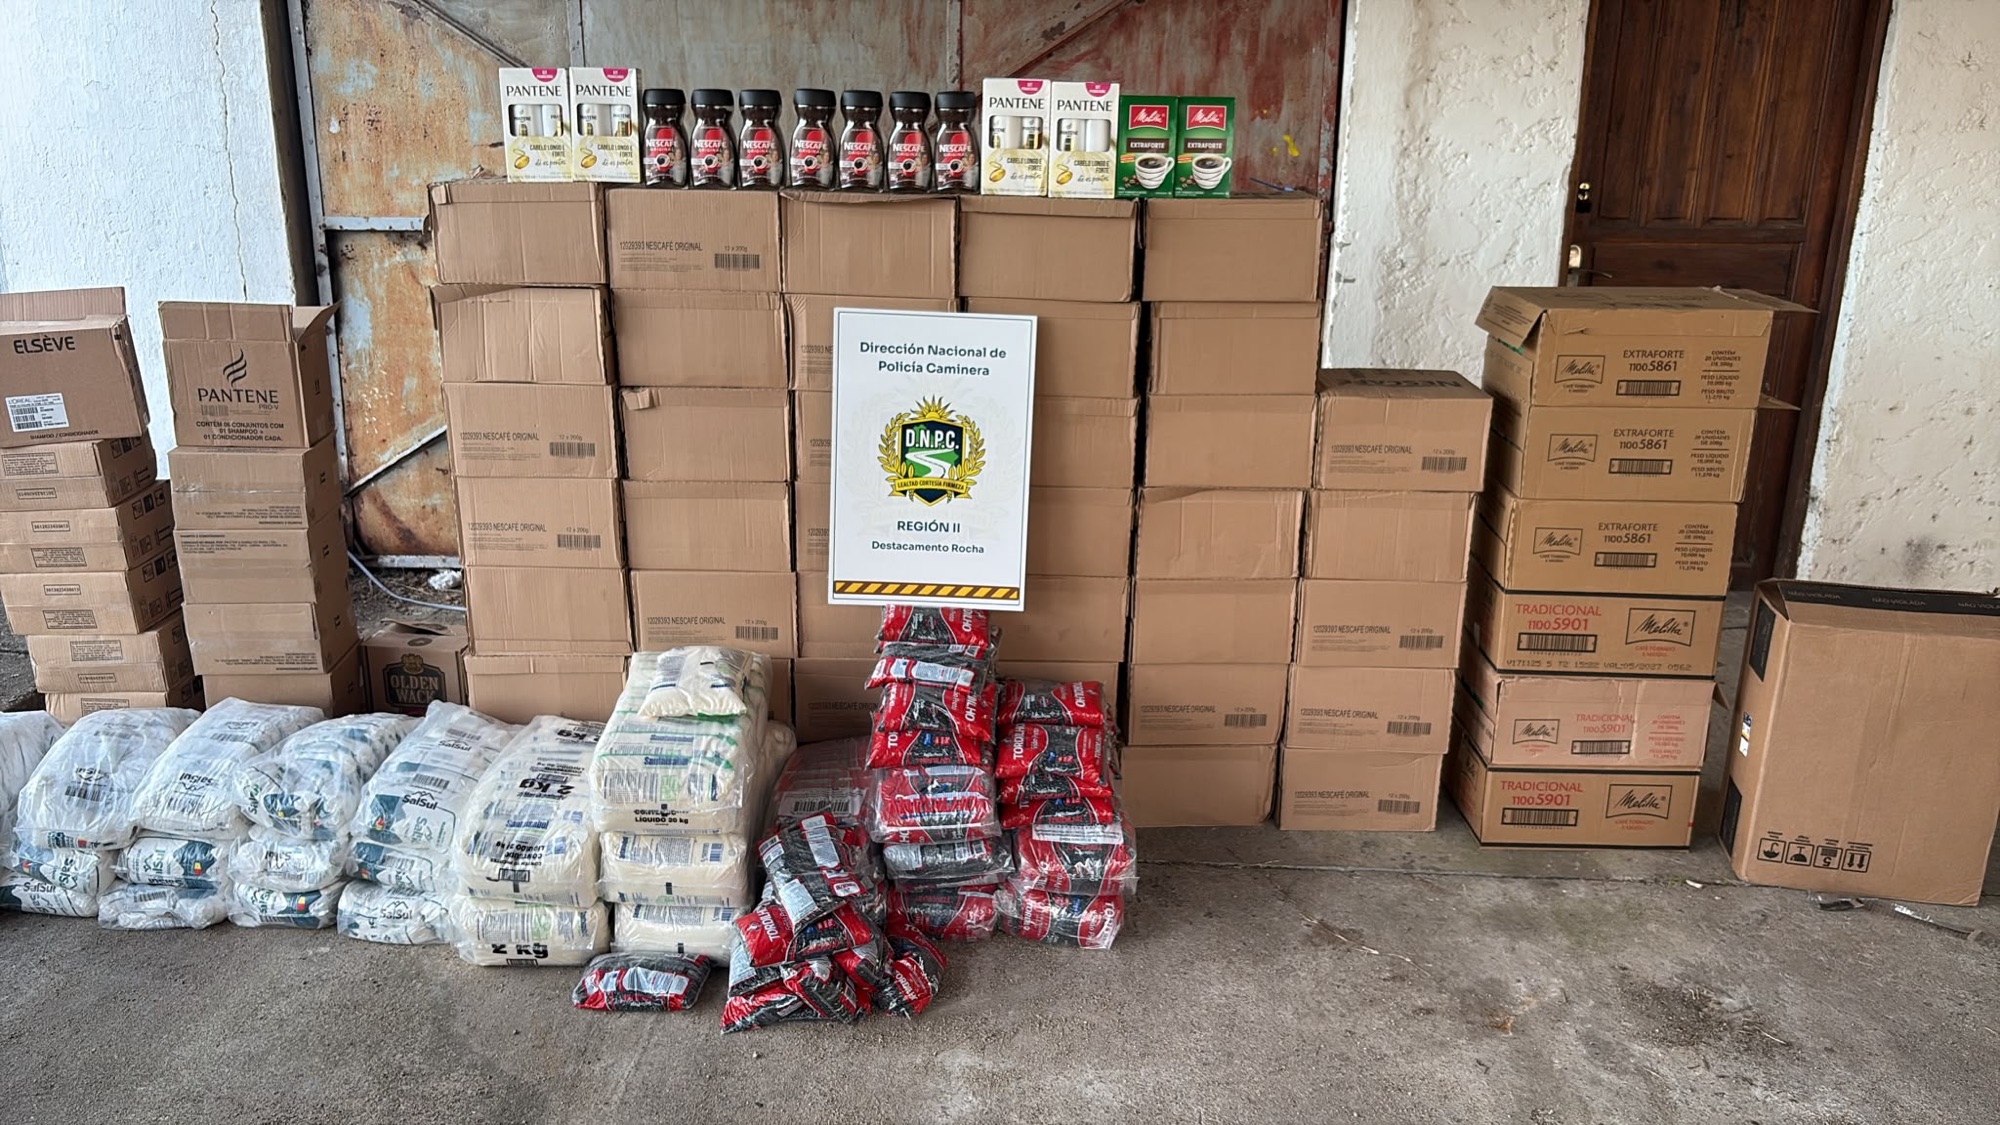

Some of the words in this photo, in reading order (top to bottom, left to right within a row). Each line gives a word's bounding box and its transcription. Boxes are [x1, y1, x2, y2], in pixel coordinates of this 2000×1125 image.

[506, 85, 562, 97] PANTENE
[575, 84, 632, 97] PANTENE
[989, 97, 1045, 109] PANTENE
[1057, 100, 1113, 111] PANTENE
[646, 240, 674, 251] NESCAFÉ
[675, 242, 703, 251] ORIGINAL
[14, 335, 76, 354] ELSÈVE
[860, 342, 924, 355] Dirección
[928, 345, 986, 358] Nacional
[990, 348, 1007, 358] de
[1623, 350, 1685, 359] EXTRAFORTE
[878, 360, 923, 373] Policía
[926, 362, 990, 376] Caminera
[1561, 359, 1596, 375] Melitta
[198, 388, 279, 404] PANTENE
[483, 431, 512, 441] NESCAFÉ
[512, 433, 539, 441] ORIGINAL
[906, 429, 960, 449] D.N.P.C.
[1613, 429, 1674, 438] EXTRAFORTE
[1355, 444, 1383, 454] NESCAFÉ
[1384, 446, 1412, 454] ORIGINAL
[1555, 434, 1588, 454] Melitta
[943, 481, 964, 490] FIRMEZA
[493, 522, 520, 532] NESCAFÉ
[520, 524, 547, 532] ORIGINAL
[897, 520, 950, 533] REGIÓN
[952, 523, 960, 533] II
[1598, 522, 1659, 532] EXTRAFORTE
[1541, 531, 1574, 548] Melitta
[872, 540, 949, 553] Destacamento
[951, 544, 984, 554] Rocha
[1516, 604, 1601, 616] TRADICIONAL
[1338, 625, 1364, 633] NESCAFÉ
[1365, 626, 1391, 634] ORIGINAL
[1634, 613, 1682, 635] Melitta
[1667, 664, 1692, 672] 0562
[391, 675, 438, 690] OLDEN
[396, 689, 435, 703] WACK
[1190, 705, 1215, 713] ORIGINAL
[1324, 709, 1351, 718] NESCAFÉ
[1352, 710, 1378, 719] ORIGINAL
[1576, 714, 1635, 722] TRADICIONAL
[1518, 723, 1552, 737] Melitta
[557, 785, 575, 794] 2
[1500, 781, 1583, 792] TRADICIONAL
[1318, 790, 1344, 799] NESCAFÉ
[1614, 789, 1660, 809] Melitta
[402, 794, 438, 810] SalSul
[23, 882, 56, 893] SalSul
[380, 908, 412, 920] SalSul
